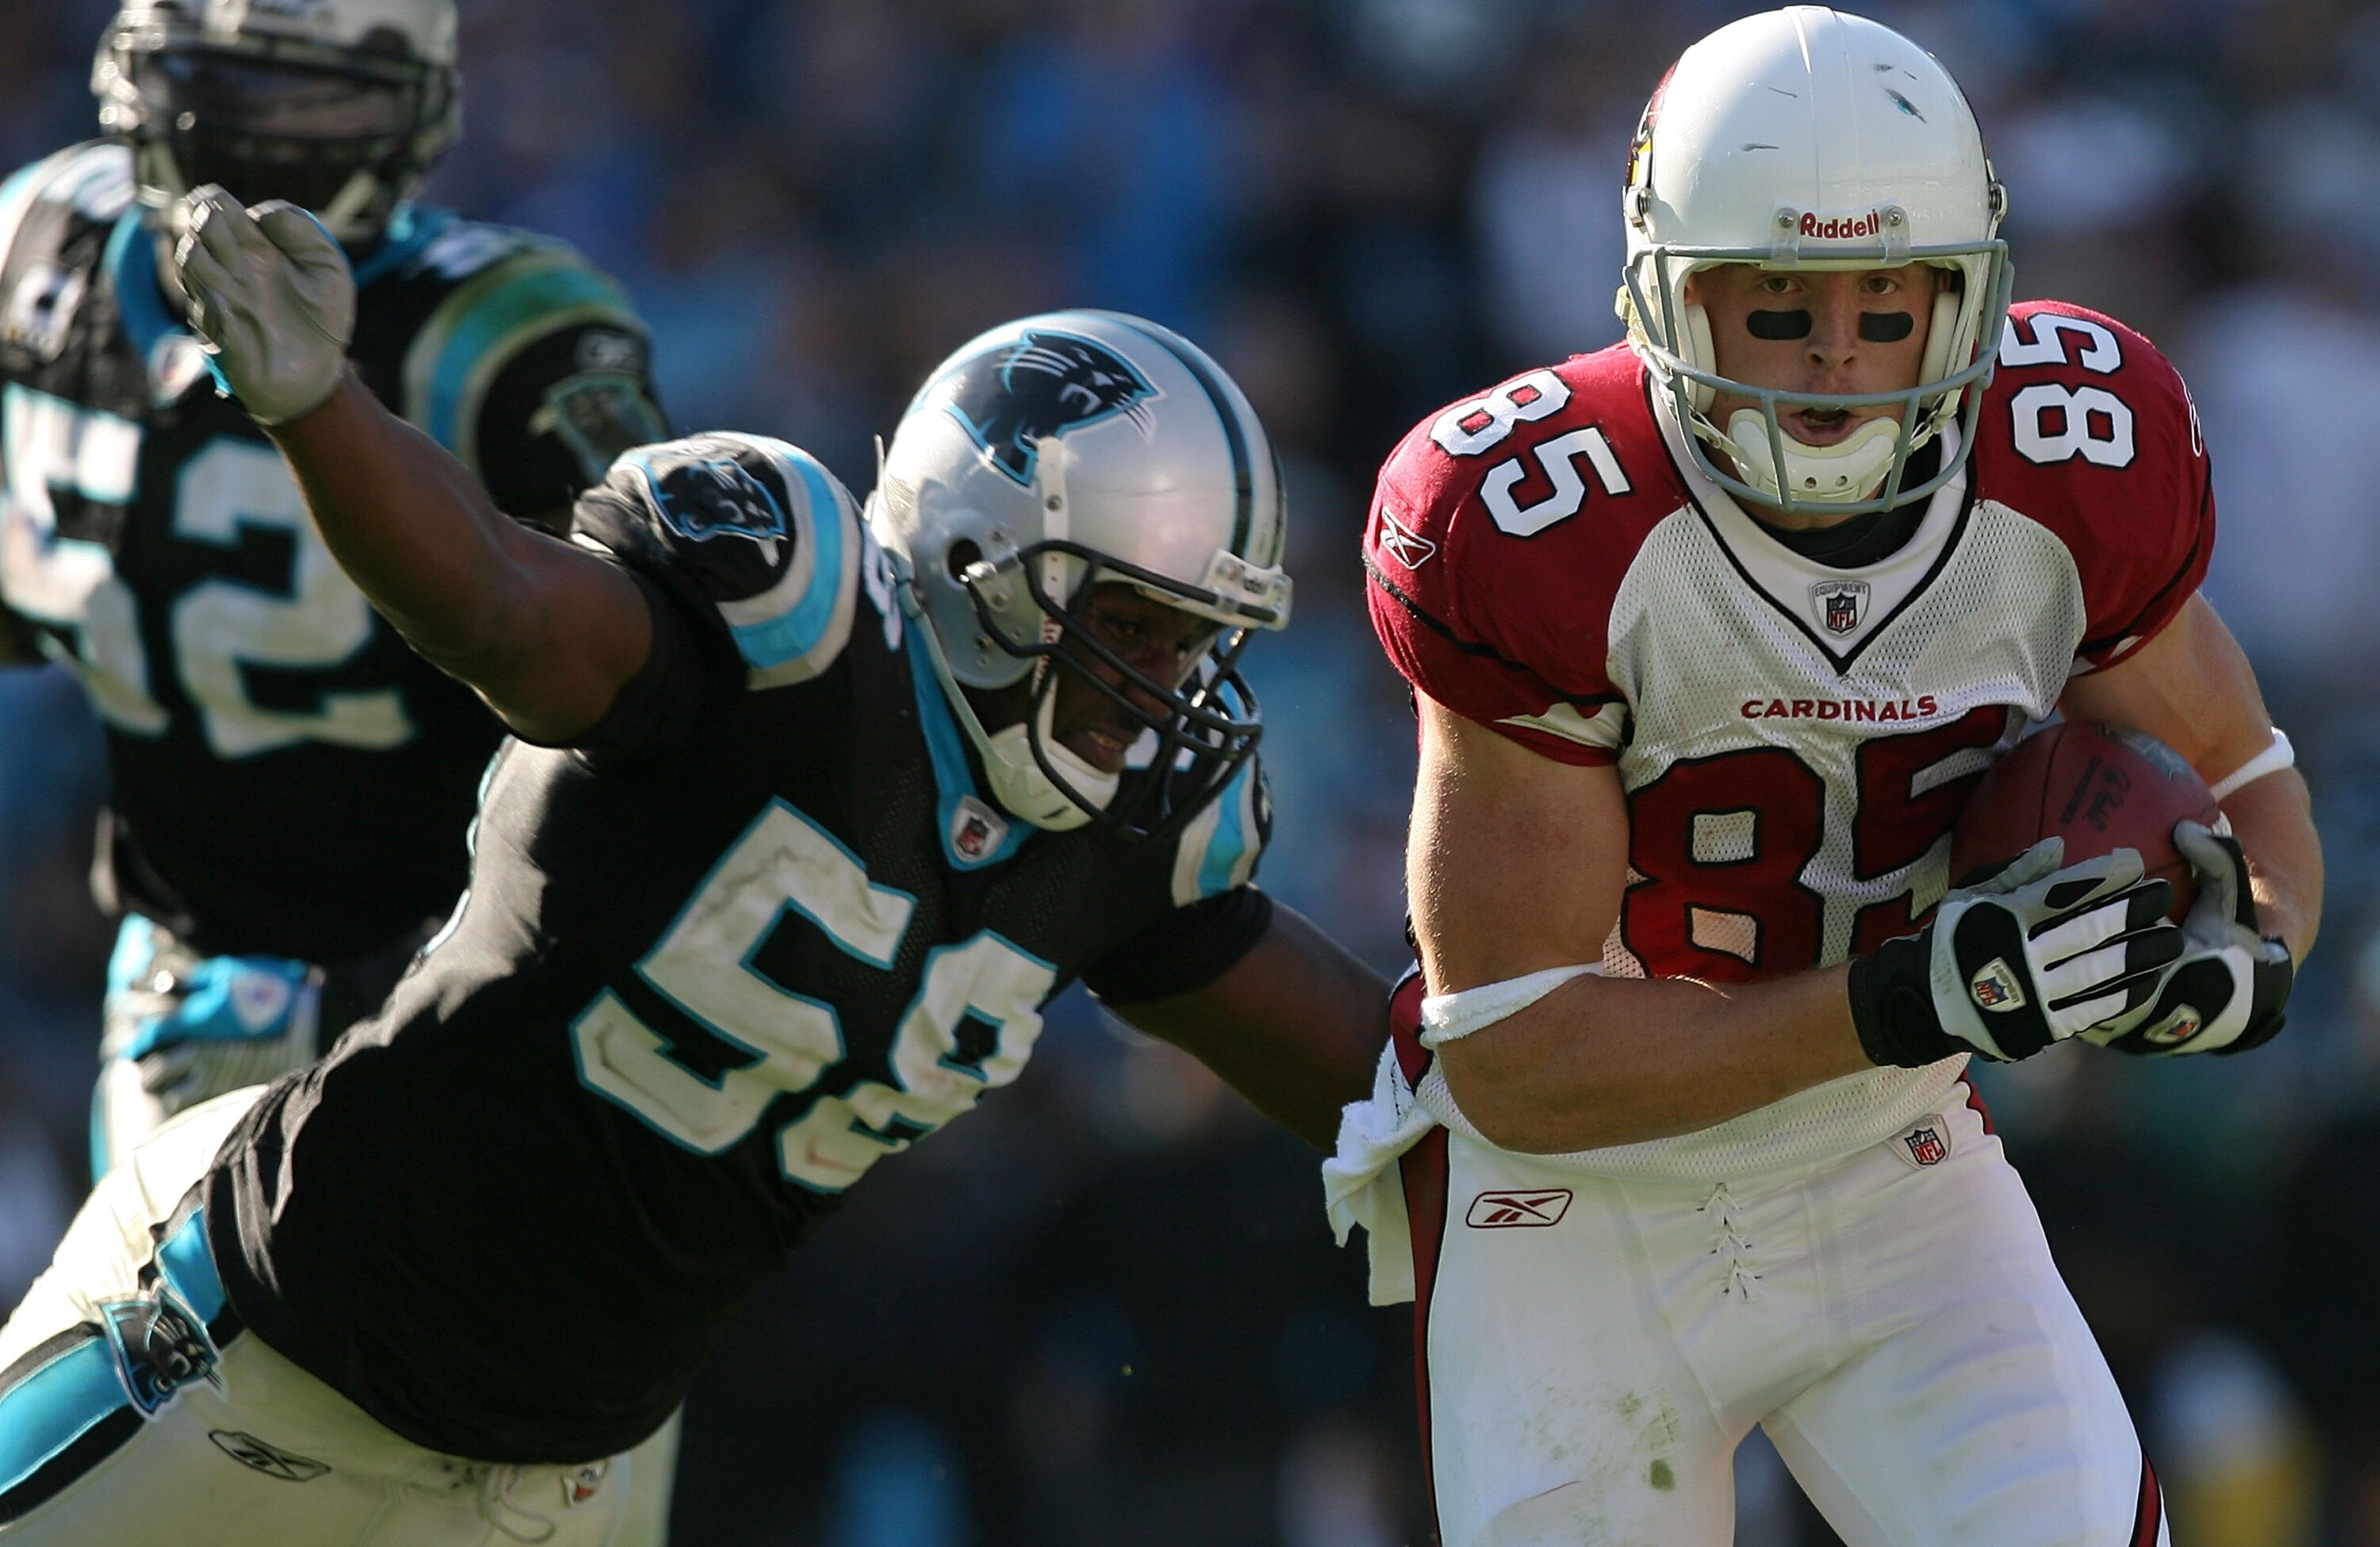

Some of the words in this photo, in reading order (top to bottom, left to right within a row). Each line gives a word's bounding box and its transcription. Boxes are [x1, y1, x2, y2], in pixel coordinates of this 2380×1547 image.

[1800, 209, 1879, 239] Riddell
[1998, 310, 2136, 470] 85
[1430, 368, 1633, 540] 85
[0, 378, 413, 760] 52
[1828, 608, 1856, 630] NFL
[1741, 695, 1938, 721] CARDINALS
[1621, 704, 2009, 980] 85
[569, 794, 1058, 1195] 58
[1975, 981, 1998, 1007] NFL
[1913, 1140, 1944, 1162] NFL
